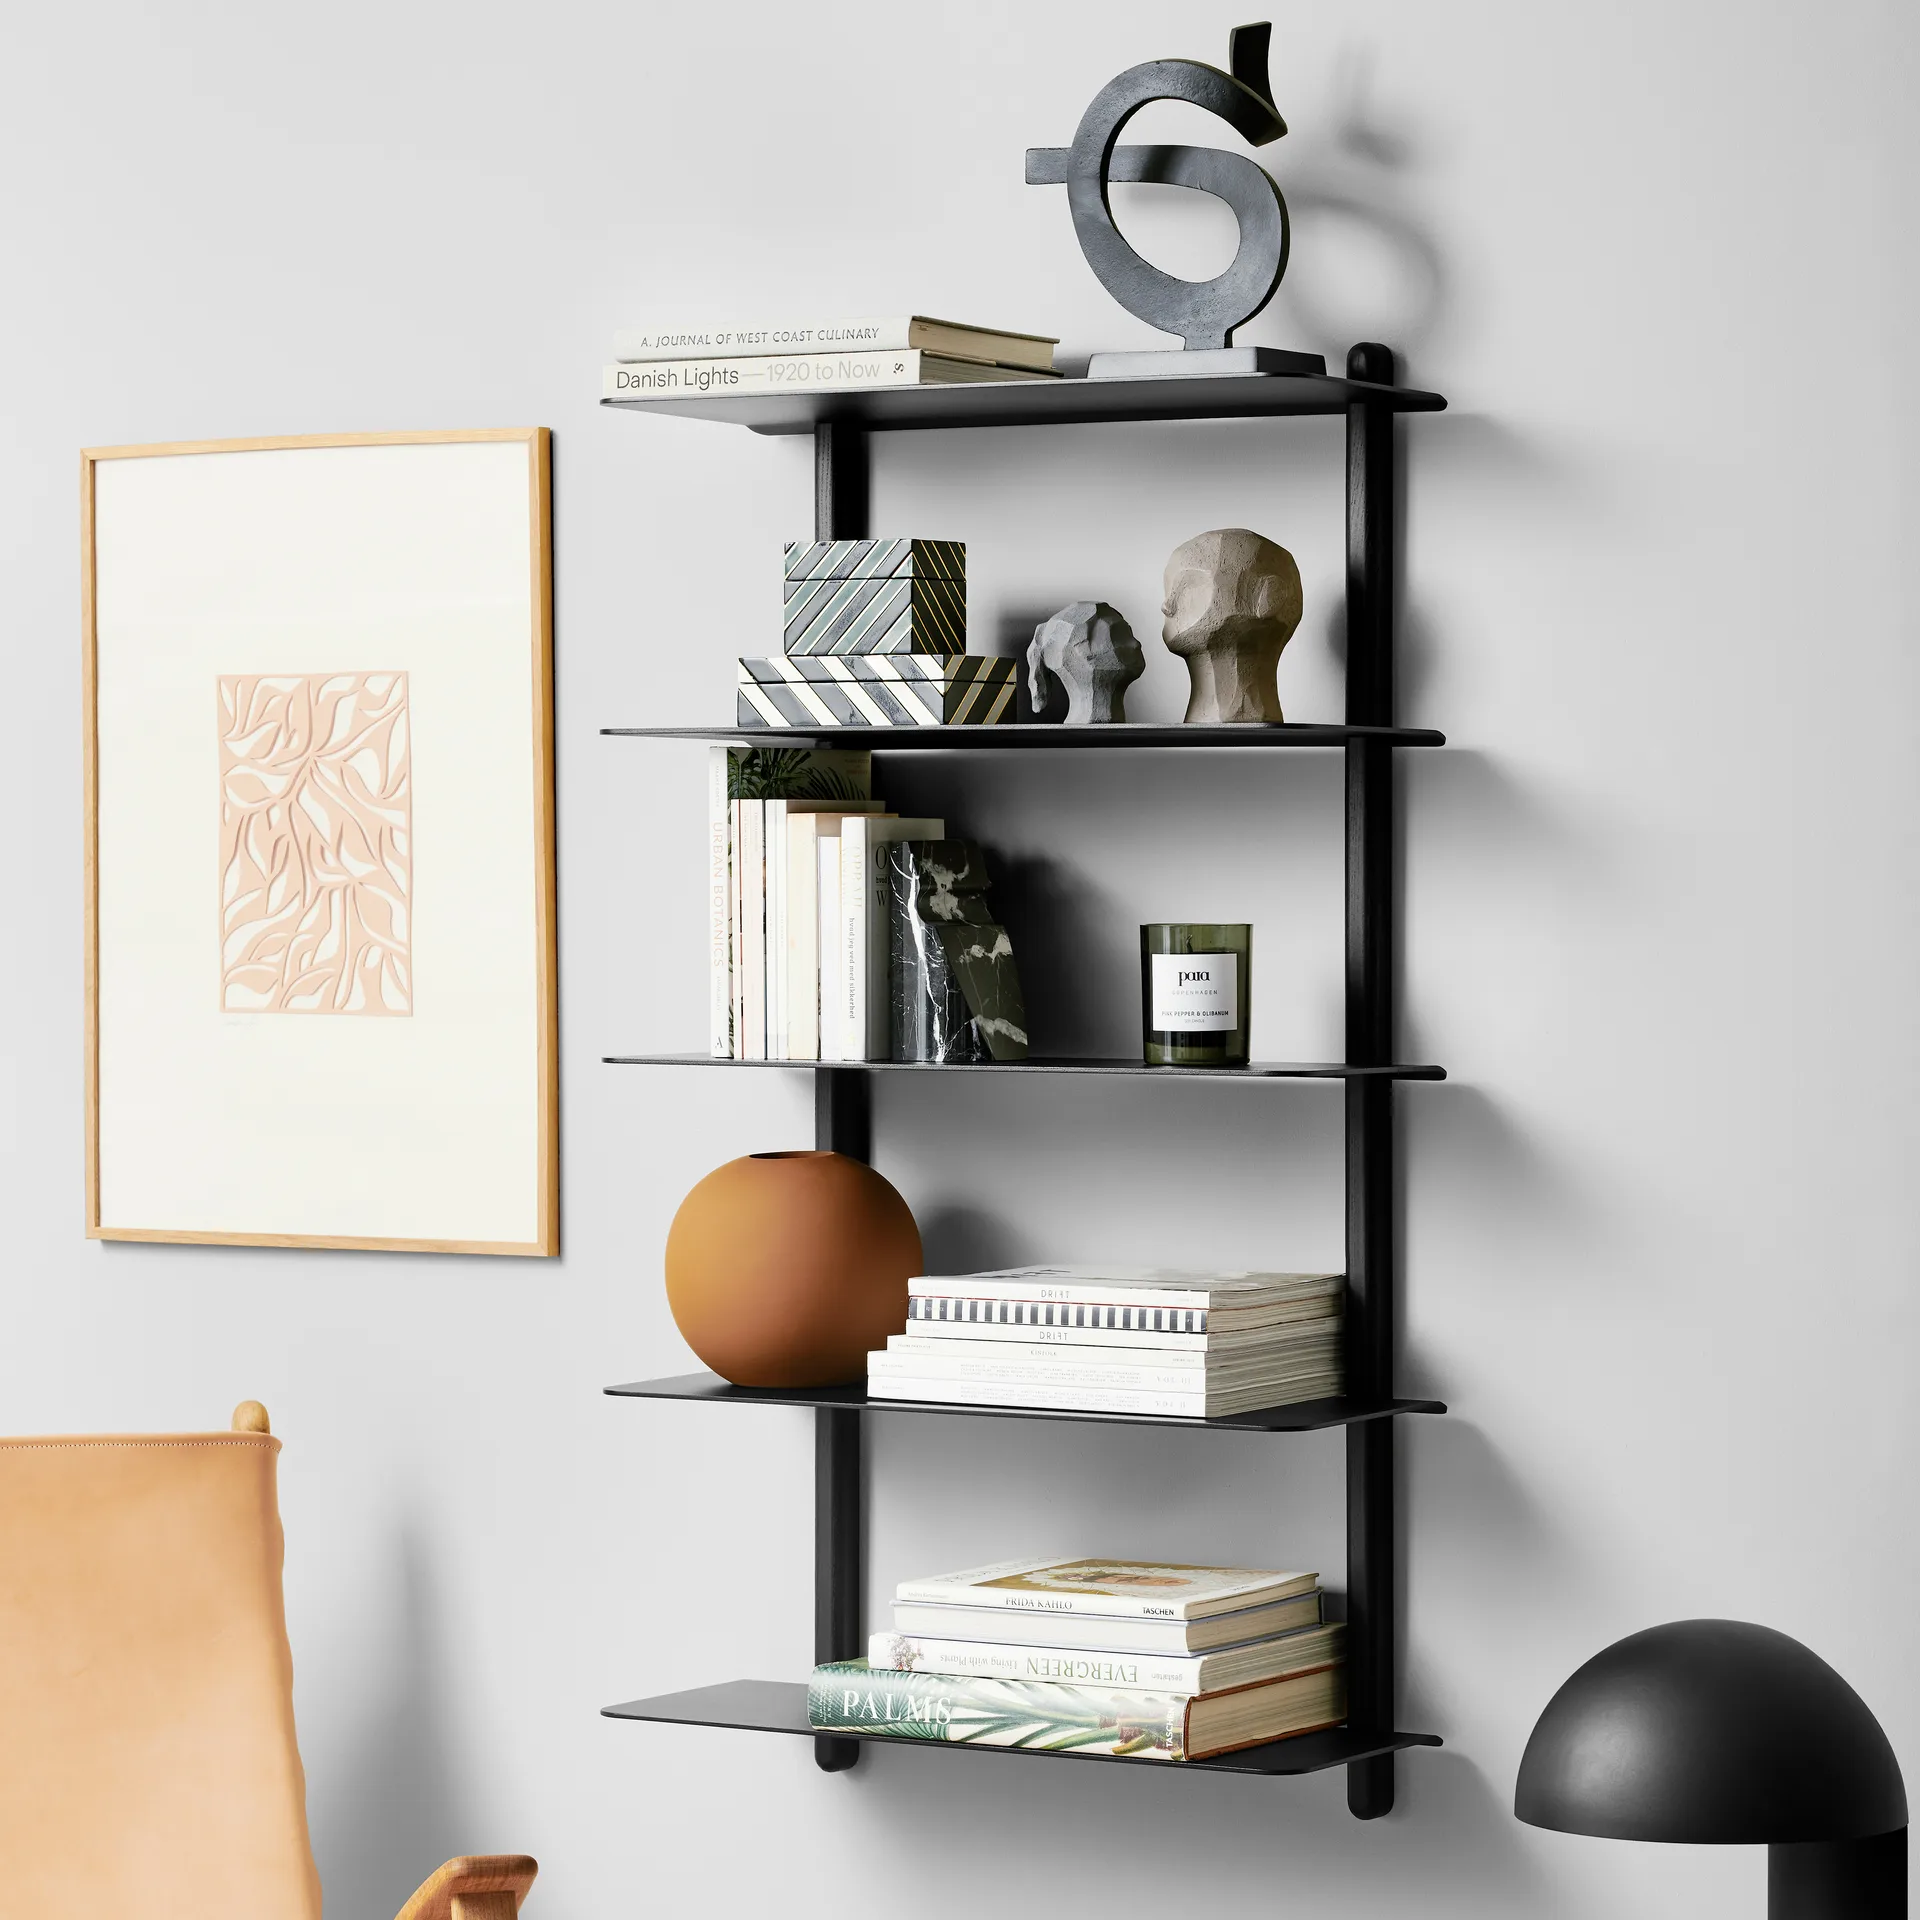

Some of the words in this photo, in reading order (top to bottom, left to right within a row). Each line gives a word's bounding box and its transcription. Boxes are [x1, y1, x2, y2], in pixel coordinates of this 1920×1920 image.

[640, 336, 652, 348] A.
[655, 333, 711, 348] JOURNAL
[715, 333, 732, 345] OF
[736, 331, 769, 344] WEST
[772, 330, 814, 343] COAST
[817, 327, 880, 342] CULINARY
[616, 369, 678, 389] Danish
[815, 364, 834, 381] to
[838, 360, 881, 379] Now
[712, 821, 724, 879] URBAN
[712, 884, 725, 968] BOTANICS
[847, 937, 855, 949] jeg
[1005, 1596, 1035, 1608] FRIDA
[1036, 1598, 1073, 1610] KAHLO
[1142, 1606, 1175, 1616] TASCHEN
[940, 1653, 967, 1666] Plants
[969, 1655, 988, 1667] with
[990, 1655, 1018, 1670] Living
[1026, 1656, 1138, 1683] EVERGREEN
[1150, 1672, 1183, 1681] gestalten
[842, 1689, 952, 1725] PALMS
[1165, 1706, 1175, 1748] TASCHEN
